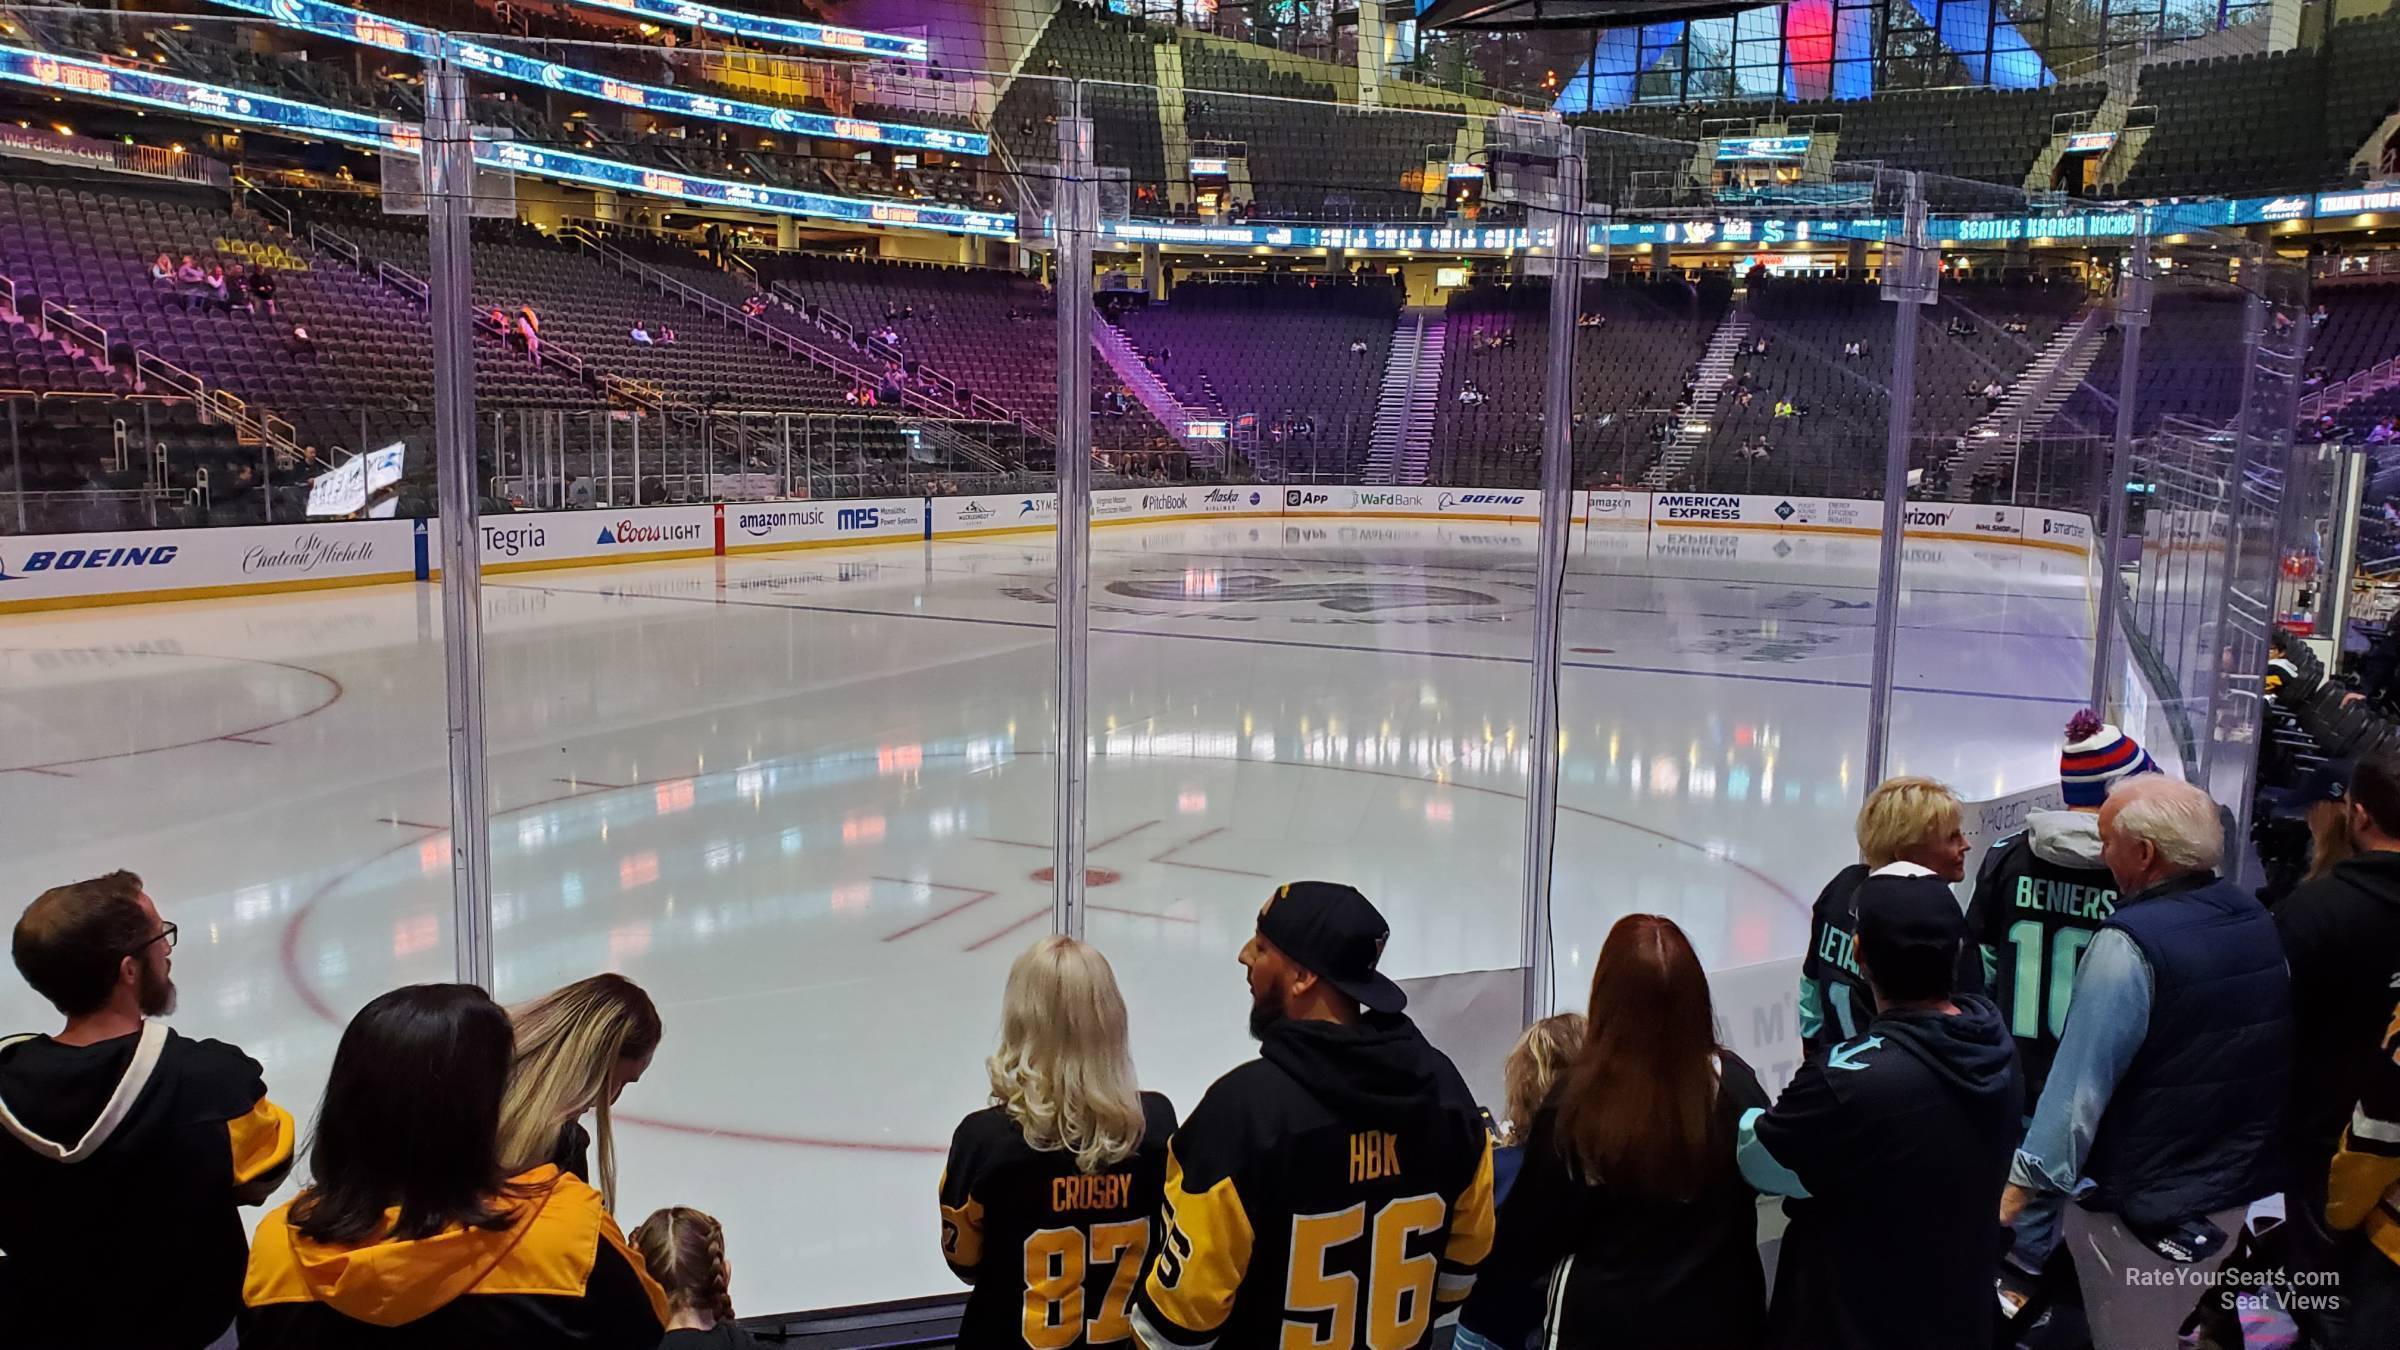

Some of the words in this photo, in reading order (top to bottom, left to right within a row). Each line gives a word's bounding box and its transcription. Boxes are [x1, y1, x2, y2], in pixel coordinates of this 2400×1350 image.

[78, 147, 113, 161] CLUB
[2320, 195, 2363, 212] THANK
[2364, 193, 2391, 209] YOU
[1959, 219, 2020, 240] SEATTLE
[2026, 217, 2085, 237] KRAKEN
[2089, 213, 2136, 235] HOCKEY
[1149, 493, 1188, 511] PitchBook
[1204, 488, 1239, 503] Alaska
[1460, 495, 1525, 505] BOEING
[1589, 499, 1631, 507] amazon
[1658, 496, 1740, 507] AMERICAN
[739, 512, 787, 530] amazon
[788, 507, 825, 526] music
[837, 508, 879, 530] MPS
[1669, 508, 1740, 520] EXPRESS
[481, 523, 545, 556] Tegria
[616, 519, 661, 544] Coors
[662, 524, 701, 541] LIGHT
[22, 546, 178, 571] BOEING
[242, 544, 310, 574] Chateau
[300, 540, 374, 572] Michelle
[2016, 875, 2118, 920] BENIERS
[2008, 920, 2092, 1042] 10
[1349, 1131, 1400, 1184] HBK
[1052, 1173, 1132, 1212] CROSBY
[1022, 1216, 1151, 1350] 87
[1281, 1193, 1447, 1350] 56
